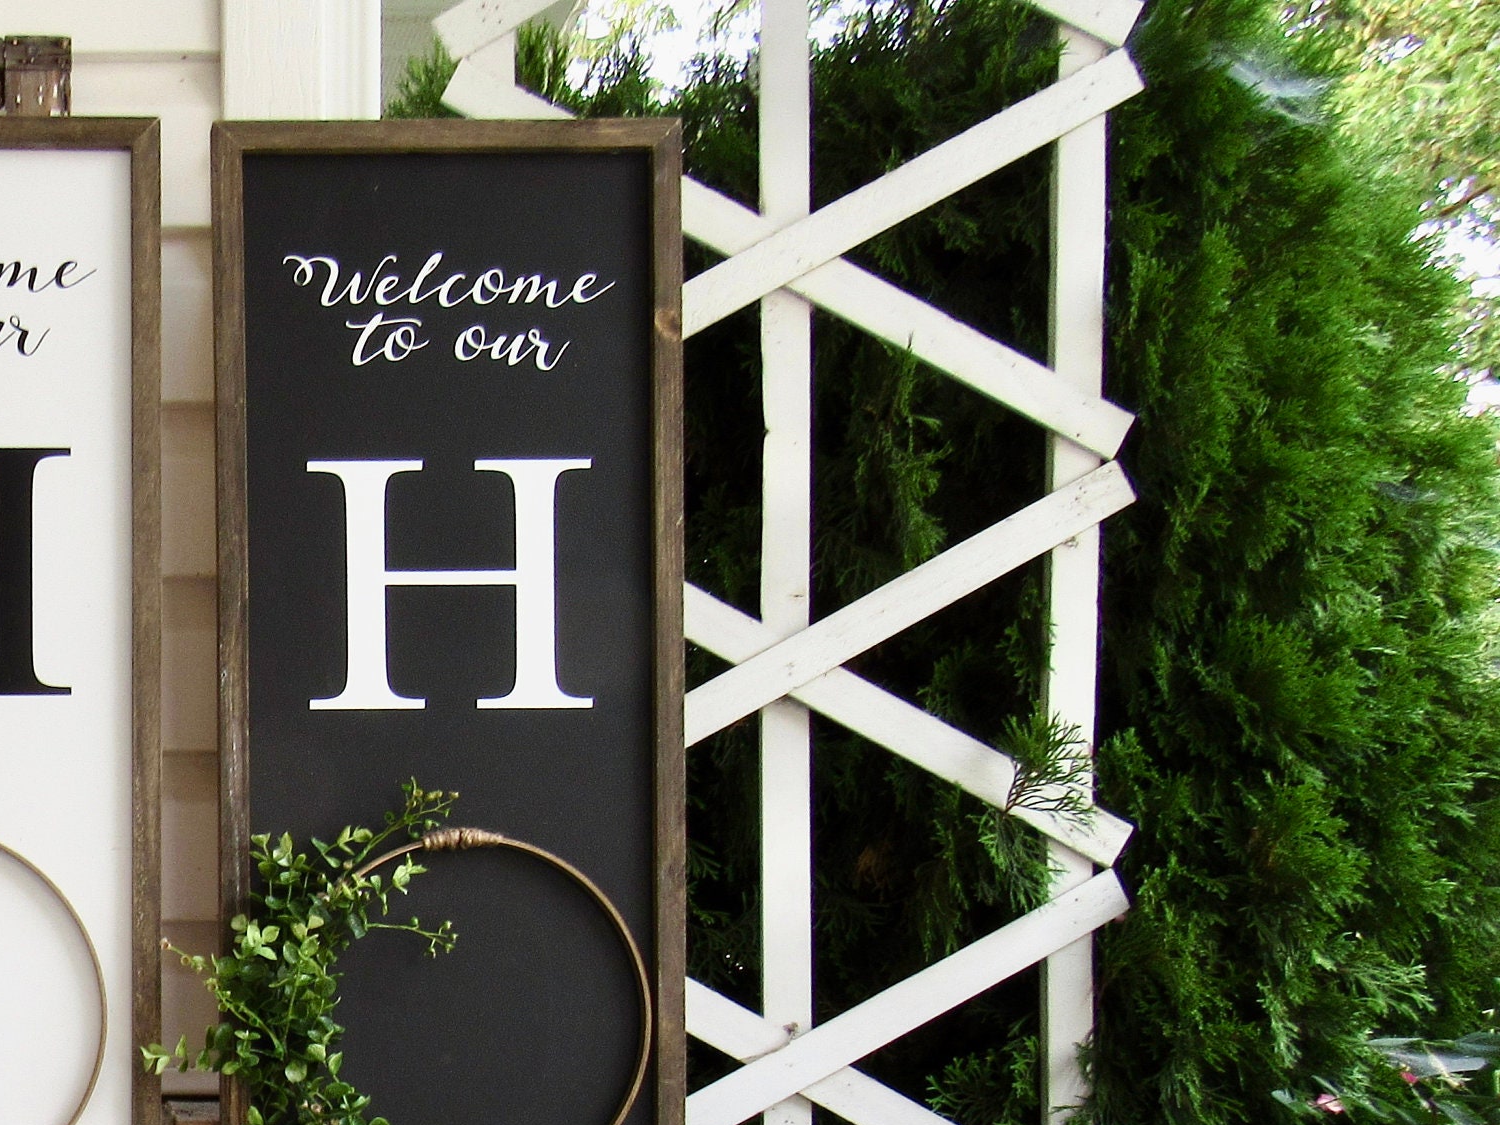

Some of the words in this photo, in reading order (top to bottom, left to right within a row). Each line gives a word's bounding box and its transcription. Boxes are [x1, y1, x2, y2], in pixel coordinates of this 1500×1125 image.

[282, 252, 616, 308] Welcome
[345, 312, 430, 367] to
[453, 324, 570, 371] our
